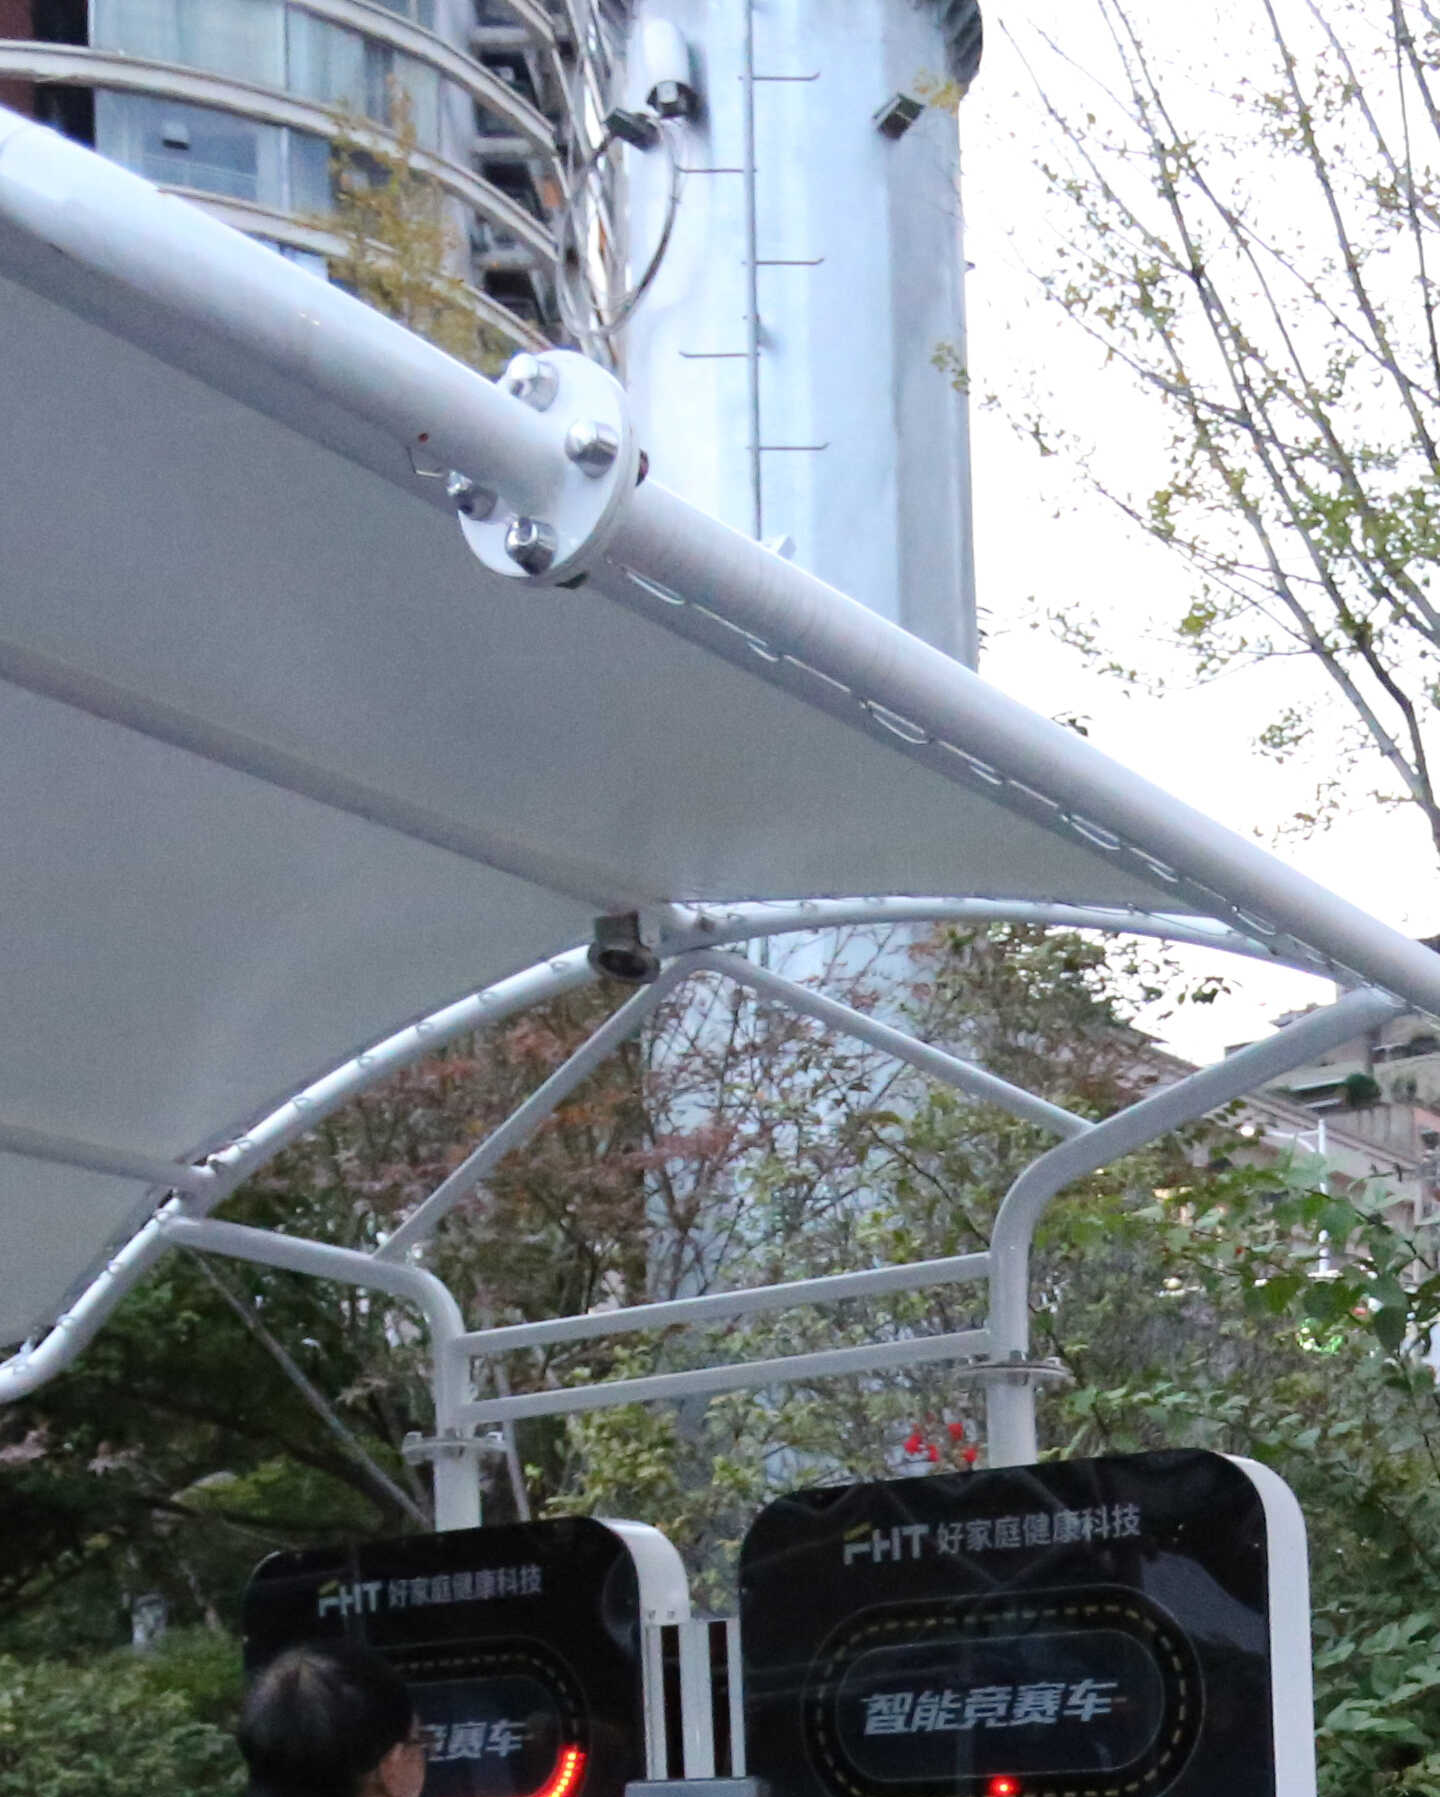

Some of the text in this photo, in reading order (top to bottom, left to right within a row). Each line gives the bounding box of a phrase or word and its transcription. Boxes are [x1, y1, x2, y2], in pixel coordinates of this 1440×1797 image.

[936, 1503, 1141, 1554] 好家庭健康科技
[864, 1678, 1119, 1736] 智能竞赛车
